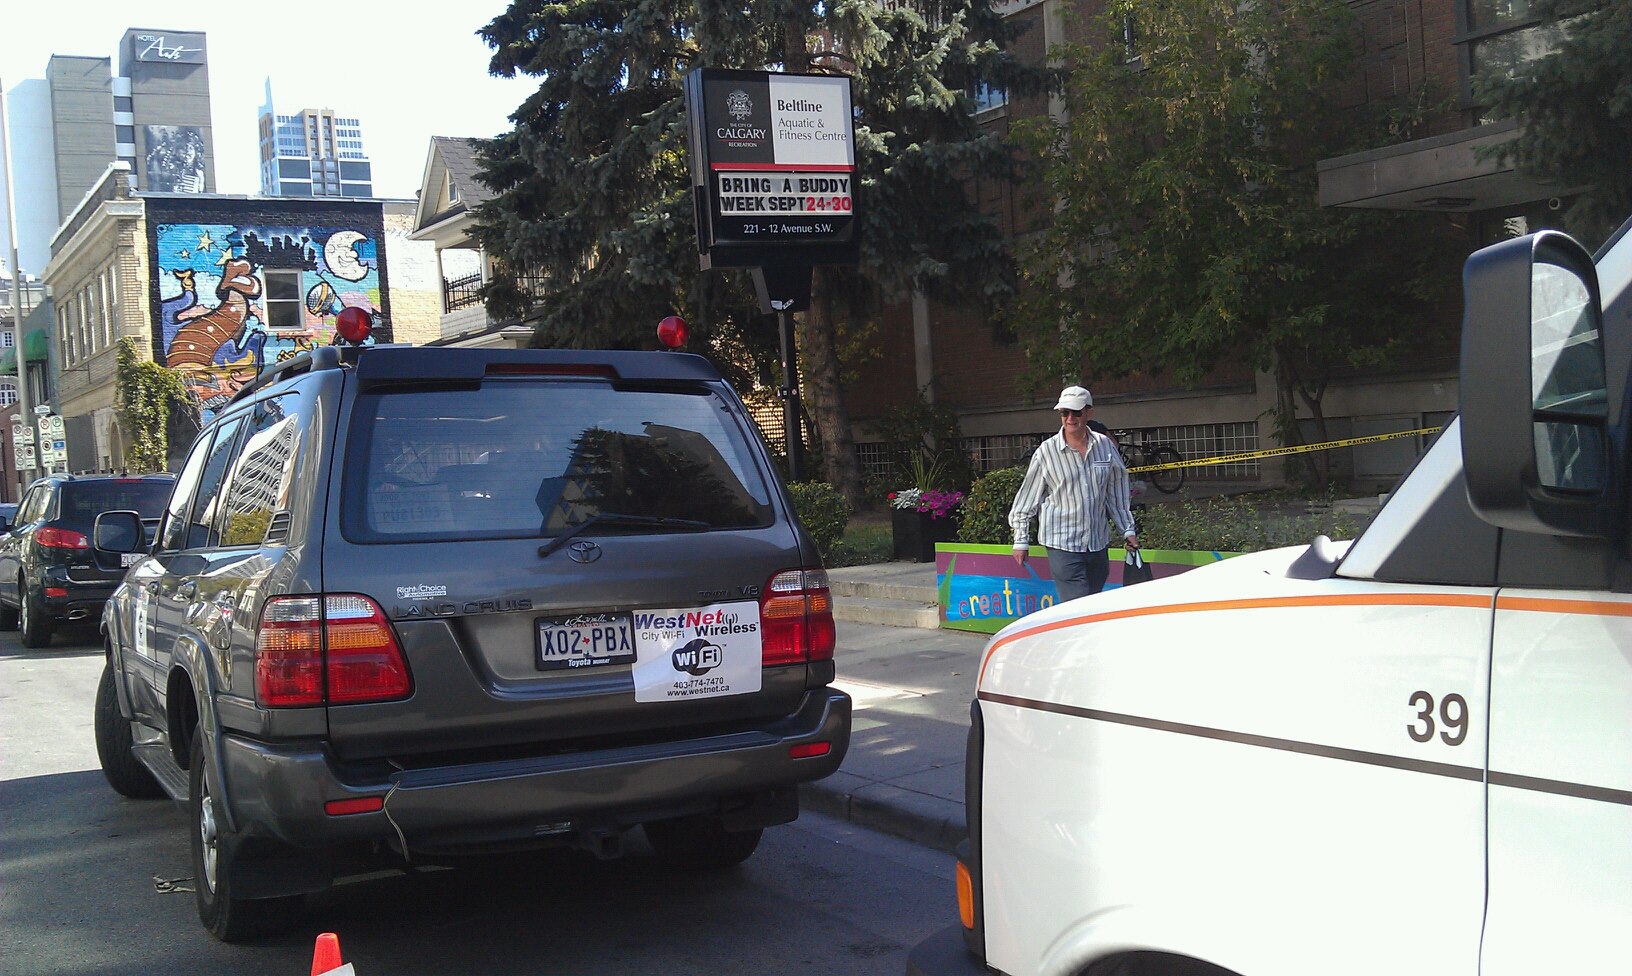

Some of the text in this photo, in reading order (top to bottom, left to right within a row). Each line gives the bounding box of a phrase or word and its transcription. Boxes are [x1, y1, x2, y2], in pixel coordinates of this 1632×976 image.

[140, 36, 203, 59] Arts
[777, 99, 823, 112] Beltline
[778, 118, 825, 130] Aquatic &
[716, 128, 767, 140] CALGARY
[779, 130, 847, 141] Fitness Centre
[722, 178, 848, 193] BRING A BUDDY
[720, 196, 852, 211] WEEK SEPT 24-30
[743, 224, 759, 234] 221
[769, 224, 778, 233] 12
[780, 224, 813, 233] Avenue
[815, 223, 834, 233] S.W.
[396, 586, 417, 594] Right
[738, 585, 759, 595] V8
[393, 599, 534, 617] LAND CRUIS
[634, 608, 723, 631] WestNet
[694, 618, 757, 638] Wireless
[592, 626, 630, 653] PBX
[641, 630, 685, 642] City Wi-Fi
[568, 658, 591, 668] Toyota
[673, 677, 724, 689] 403-774-7470
[667, 685, 730, 697] www.westnet.ca
[1406, 690, 1469, 747] 39
